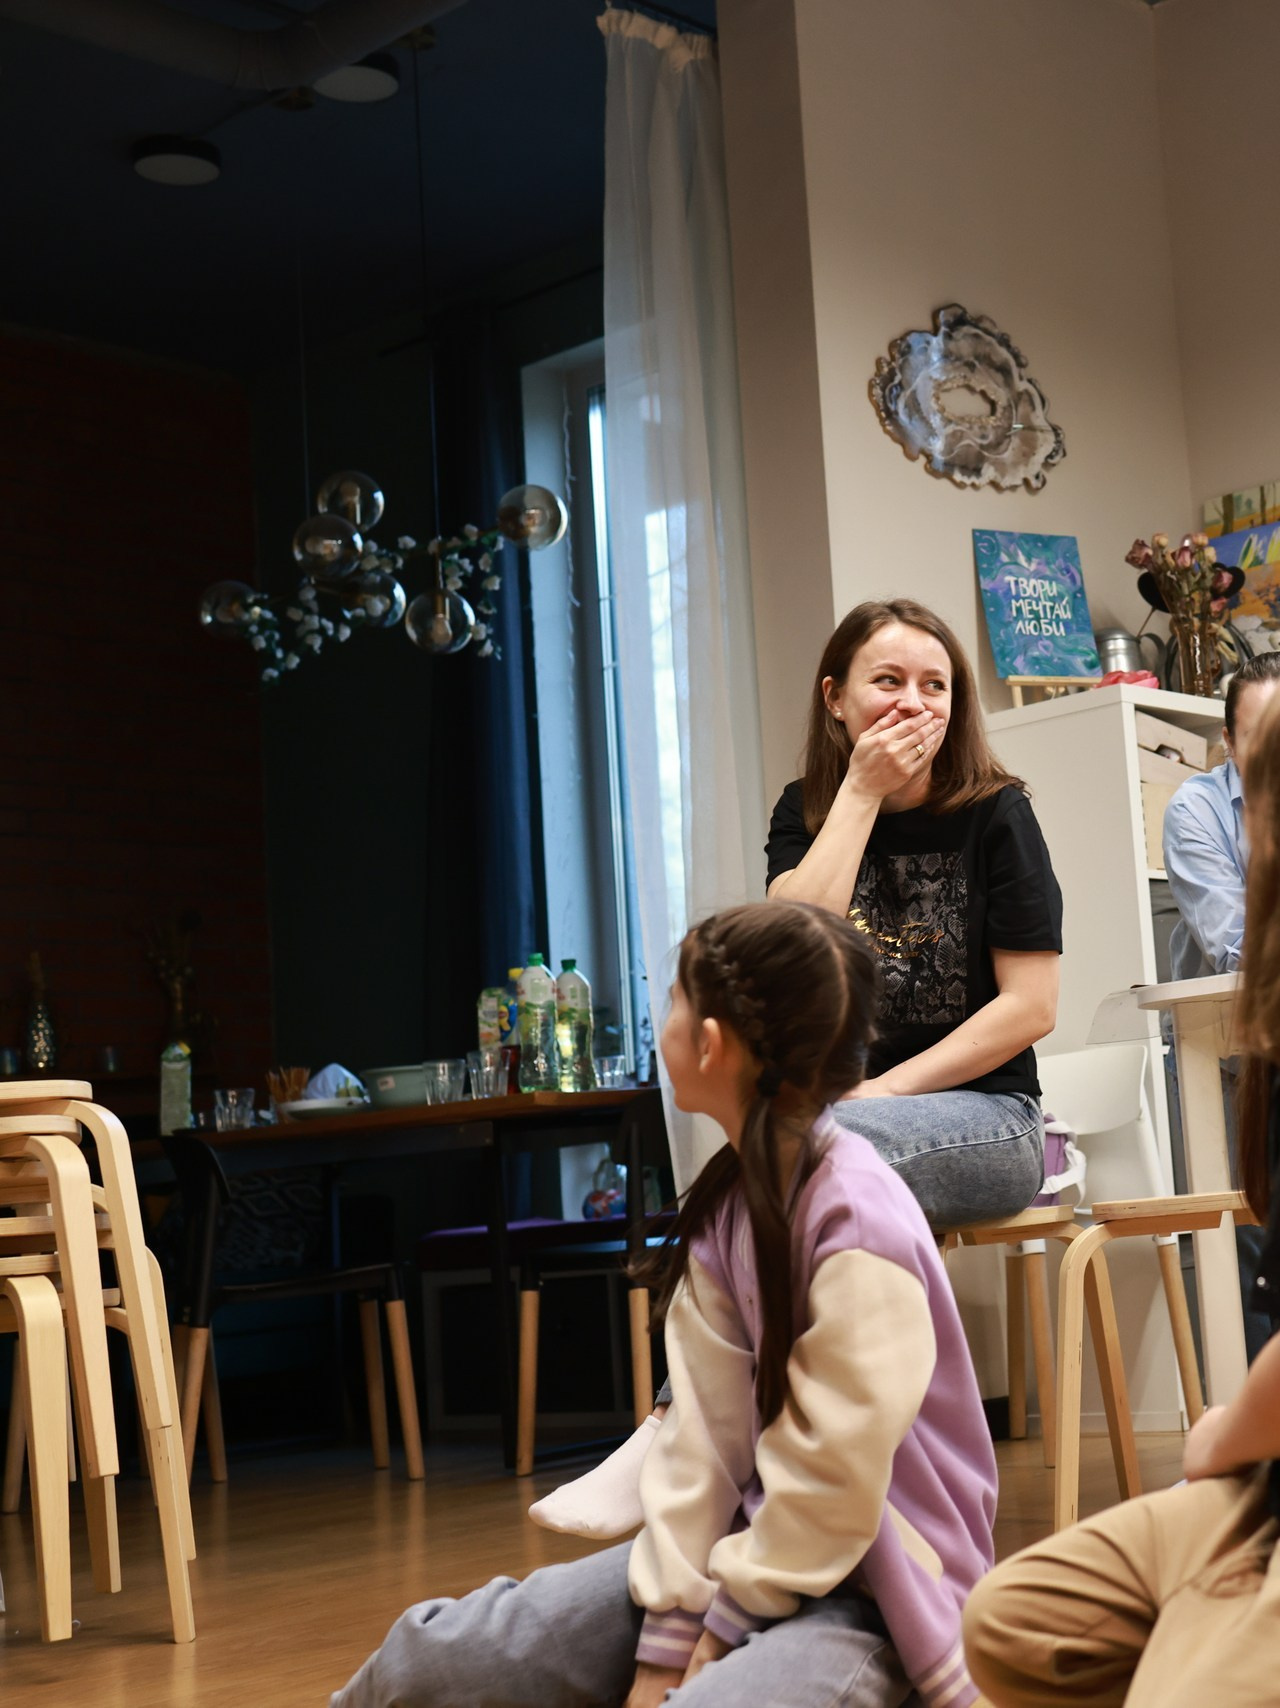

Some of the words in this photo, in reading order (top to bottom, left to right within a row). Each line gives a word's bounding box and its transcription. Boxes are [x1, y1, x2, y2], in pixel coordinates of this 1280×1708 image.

[1004, 576, 1057, 600] ТВОРИ
[1011, 597, 1072, 619] МЕЧТАЙ
[1014, 619, 1066, 636] ЛЮБИ
